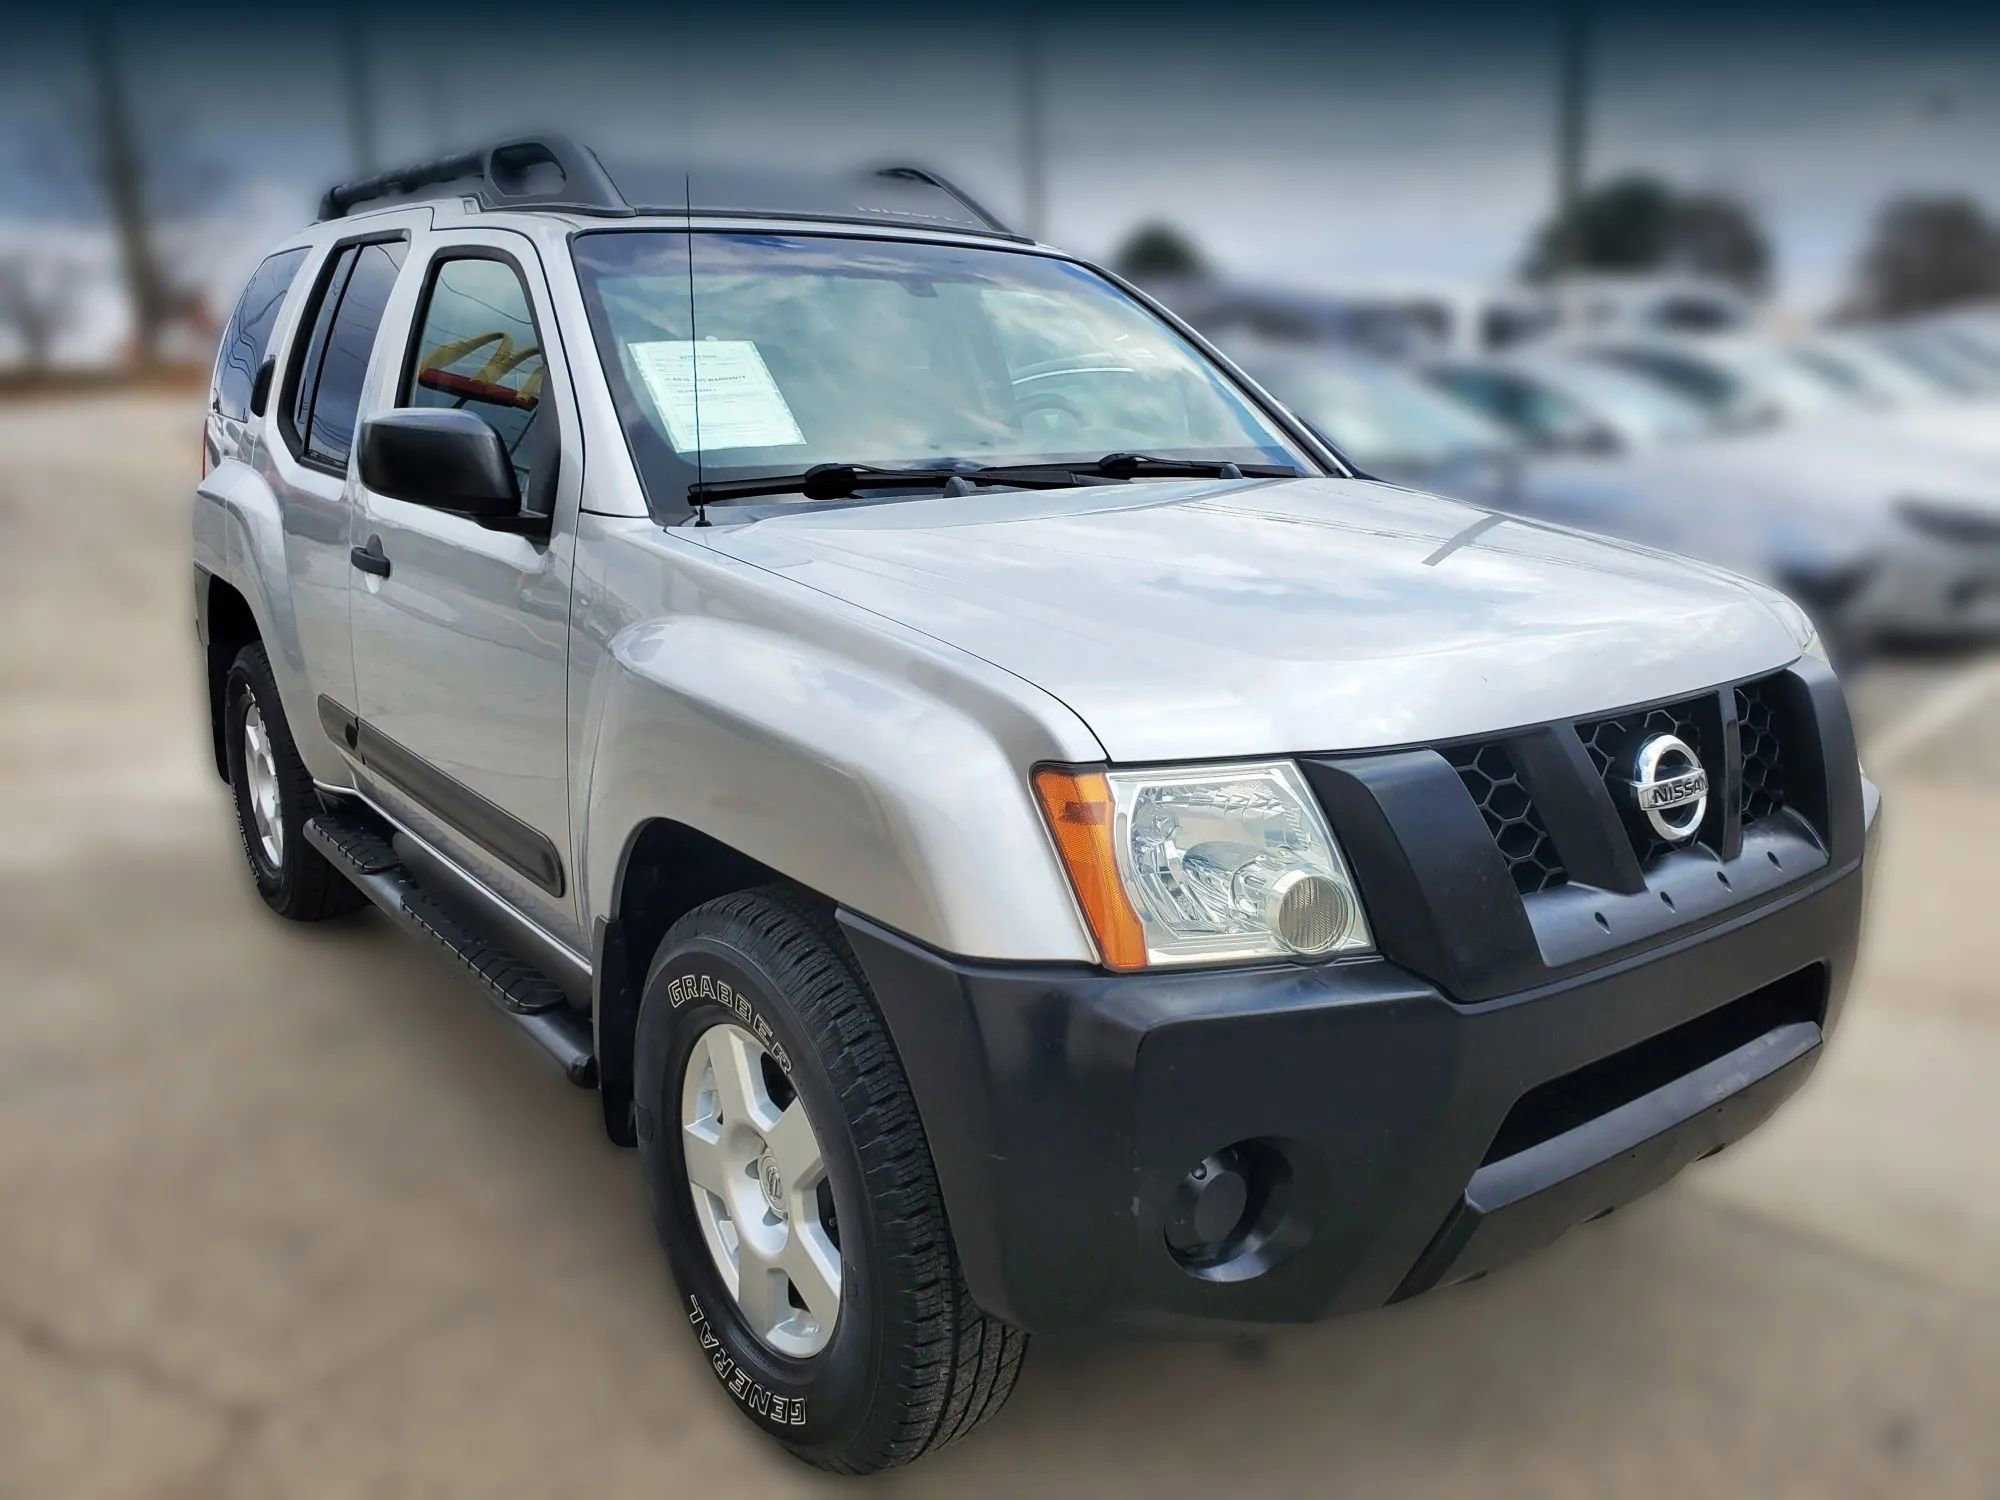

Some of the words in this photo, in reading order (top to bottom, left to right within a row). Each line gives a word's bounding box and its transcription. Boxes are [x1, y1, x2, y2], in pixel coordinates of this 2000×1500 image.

[1653, 776, 1708, 804] NISSAN
[667, 974, 792, 1075] GRABBER
[689, 1294, 806, 1425] GENERAL
